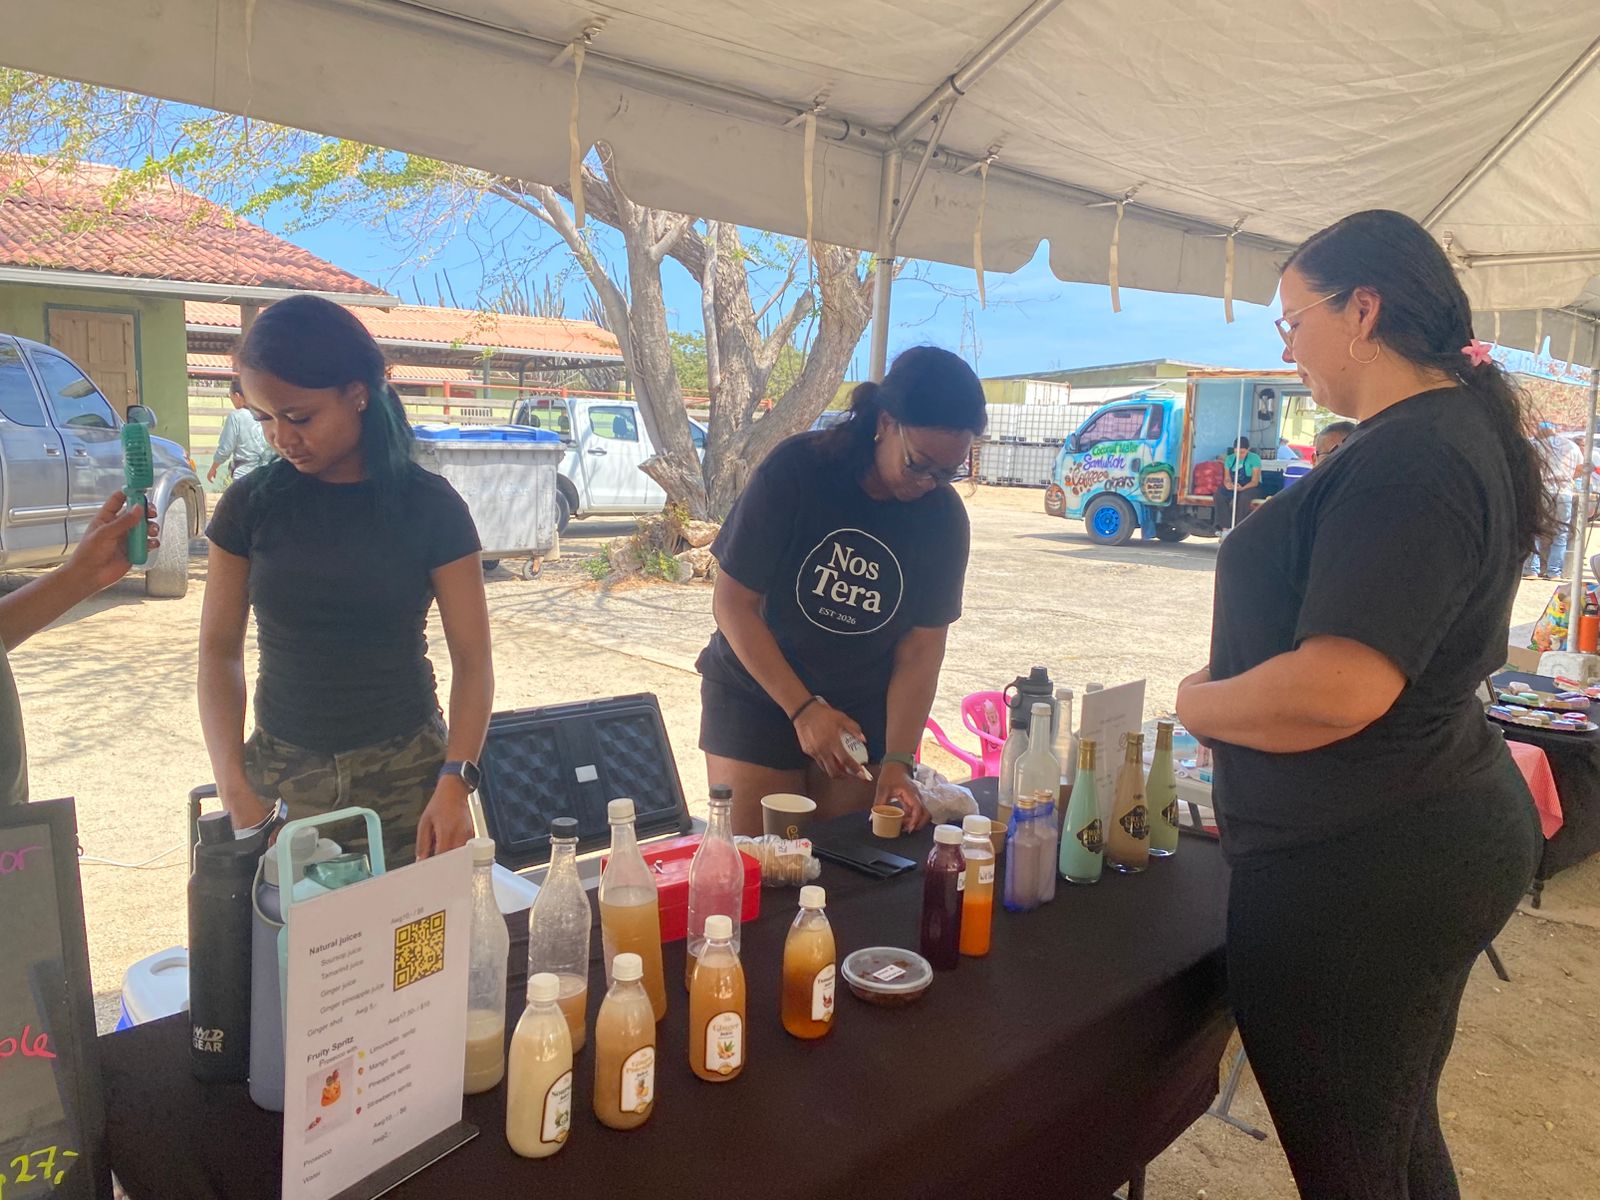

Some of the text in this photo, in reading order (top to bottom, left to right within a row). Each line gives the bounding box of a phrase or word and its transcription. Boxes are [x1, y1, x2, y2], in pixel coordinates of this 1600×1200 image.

[827, 542, 880, 581] Nos
[811, 565, 881, 614] Tera
[818, 607, 857, 625] EST 2026
[309, 931, 362, 956] Natural juices
[347, 946, 362, 958] juice
[349, 959, 364, 971] juice
[320, 979, 356, 998] Ginger juice
[320, 1001, 340, 1015] Ginger
[370, 983, 385, 994] juice
[307, 1023, 329, 1037] Ginger
[329, 1016, 344, 1027] shot
[192, 1038, 223, 1053] GEAR
[306, 1035, 354, 1064] Fruity Spritz
